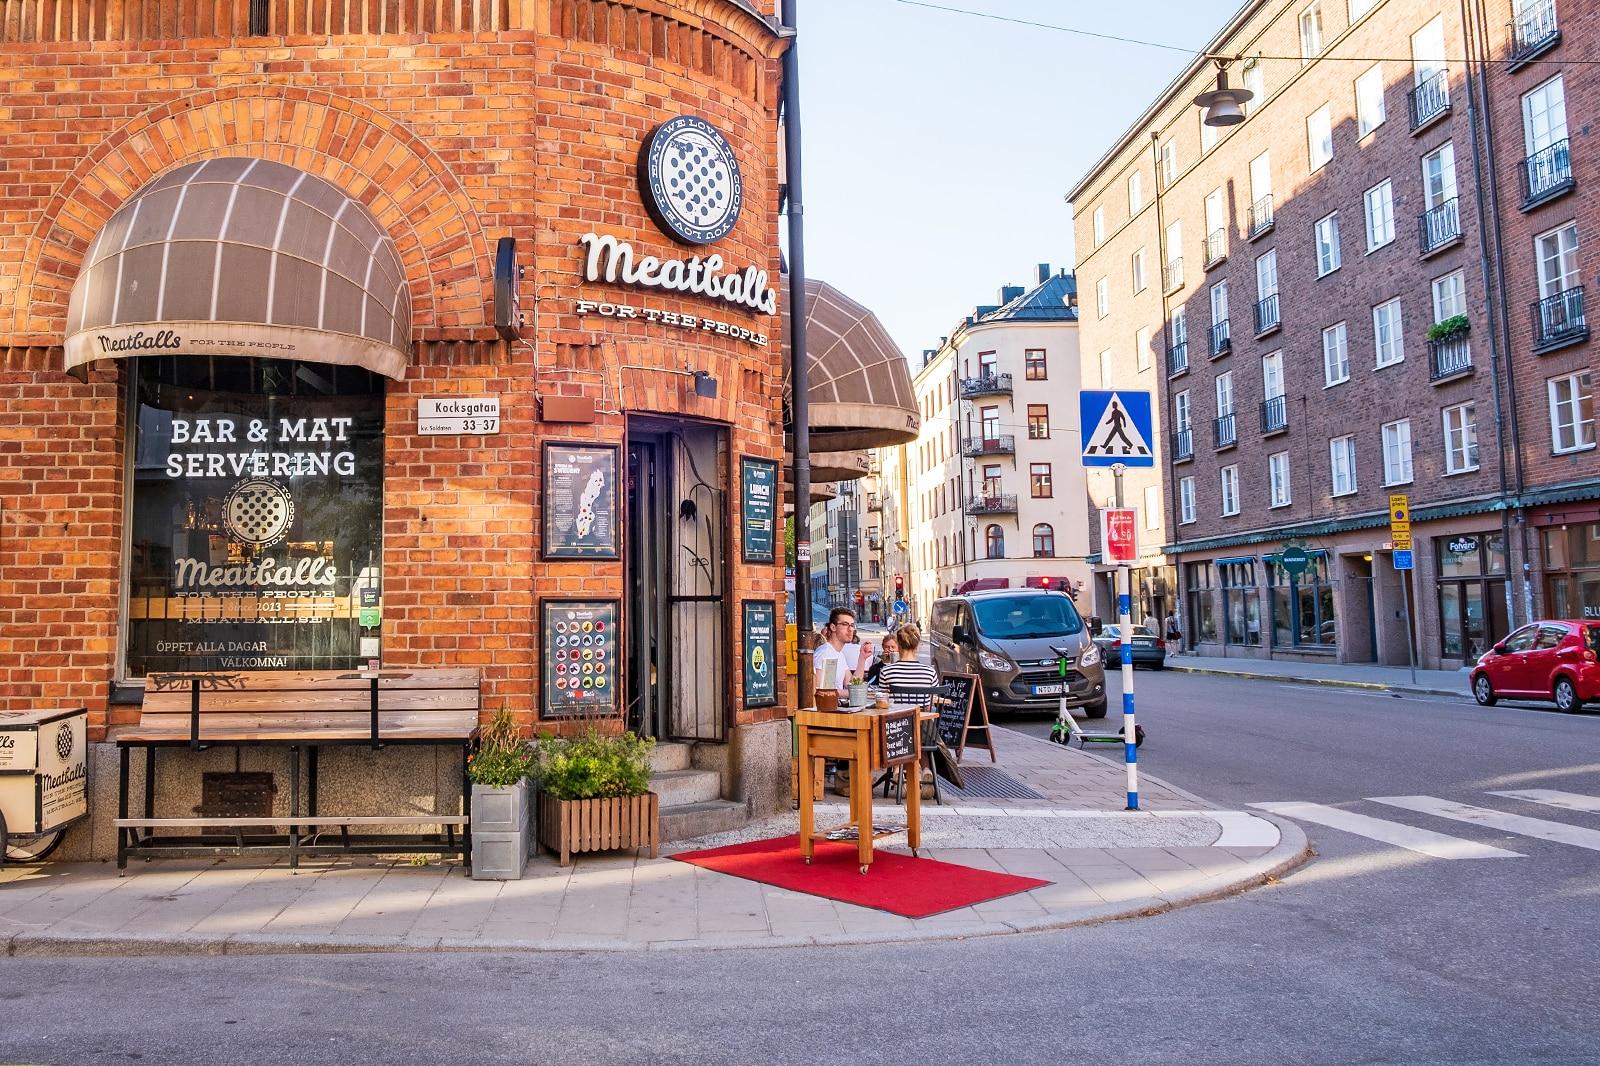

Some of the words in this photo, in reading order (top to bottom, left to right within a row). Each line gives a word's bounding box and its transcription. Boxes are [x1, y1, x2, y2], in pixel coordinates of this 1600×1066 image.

[651, 140, 663, 179] EAT
[664, 119, 686, 134] WE
[689, 119, 725, 146] LOVE
[725, 147, 737, 170] TO
[731, 174, 741, 217] COOK
[654, 183, 665, 208] TO
[665, 209, 702, 240] LOVE
[705, 222, 731, 240] YOU
[581, 232, 777, 316] Meatballs
[576, 301, 637, 319] FOR
[643, 308, 697, 328] THE
[702, 319, 769, 347] PEOPLE
[98, 330, 181, 353] Meatballs
[250, 341, 296, 351] PEOPLE
[436, 401, 497, 416] Kocksgatan
[171, 419, 237, 444] BAR
[247, 419, 269, 442] &
[279, 417, 353, 442] MAT
[166, 451, 356, 478] SERVERING
[231, 477, 249, 490] WE
[252, 475, 281, 487] LOVE
[282, 485, 292, 499] TO
[286, 501, 295, 529] COOK
[264, 534, 286, 549] YOU
[175, 557, 337, 588] Meatballs
[175, 591, 213, 599] FOR
[217, 591, 257, 599] THE
[262, 590, 336, 599] PEOPLE
[255, 602, 282, 612] 2013
[156, 639, 195, 652] ÖPPET
[195, 640, 225, 652] ALLA
[228, 640, 268, 652] DAGAR
[220, 655, 287, 668] VÄLKOMNA!
[42, 762, 87, 792] Meatballs
